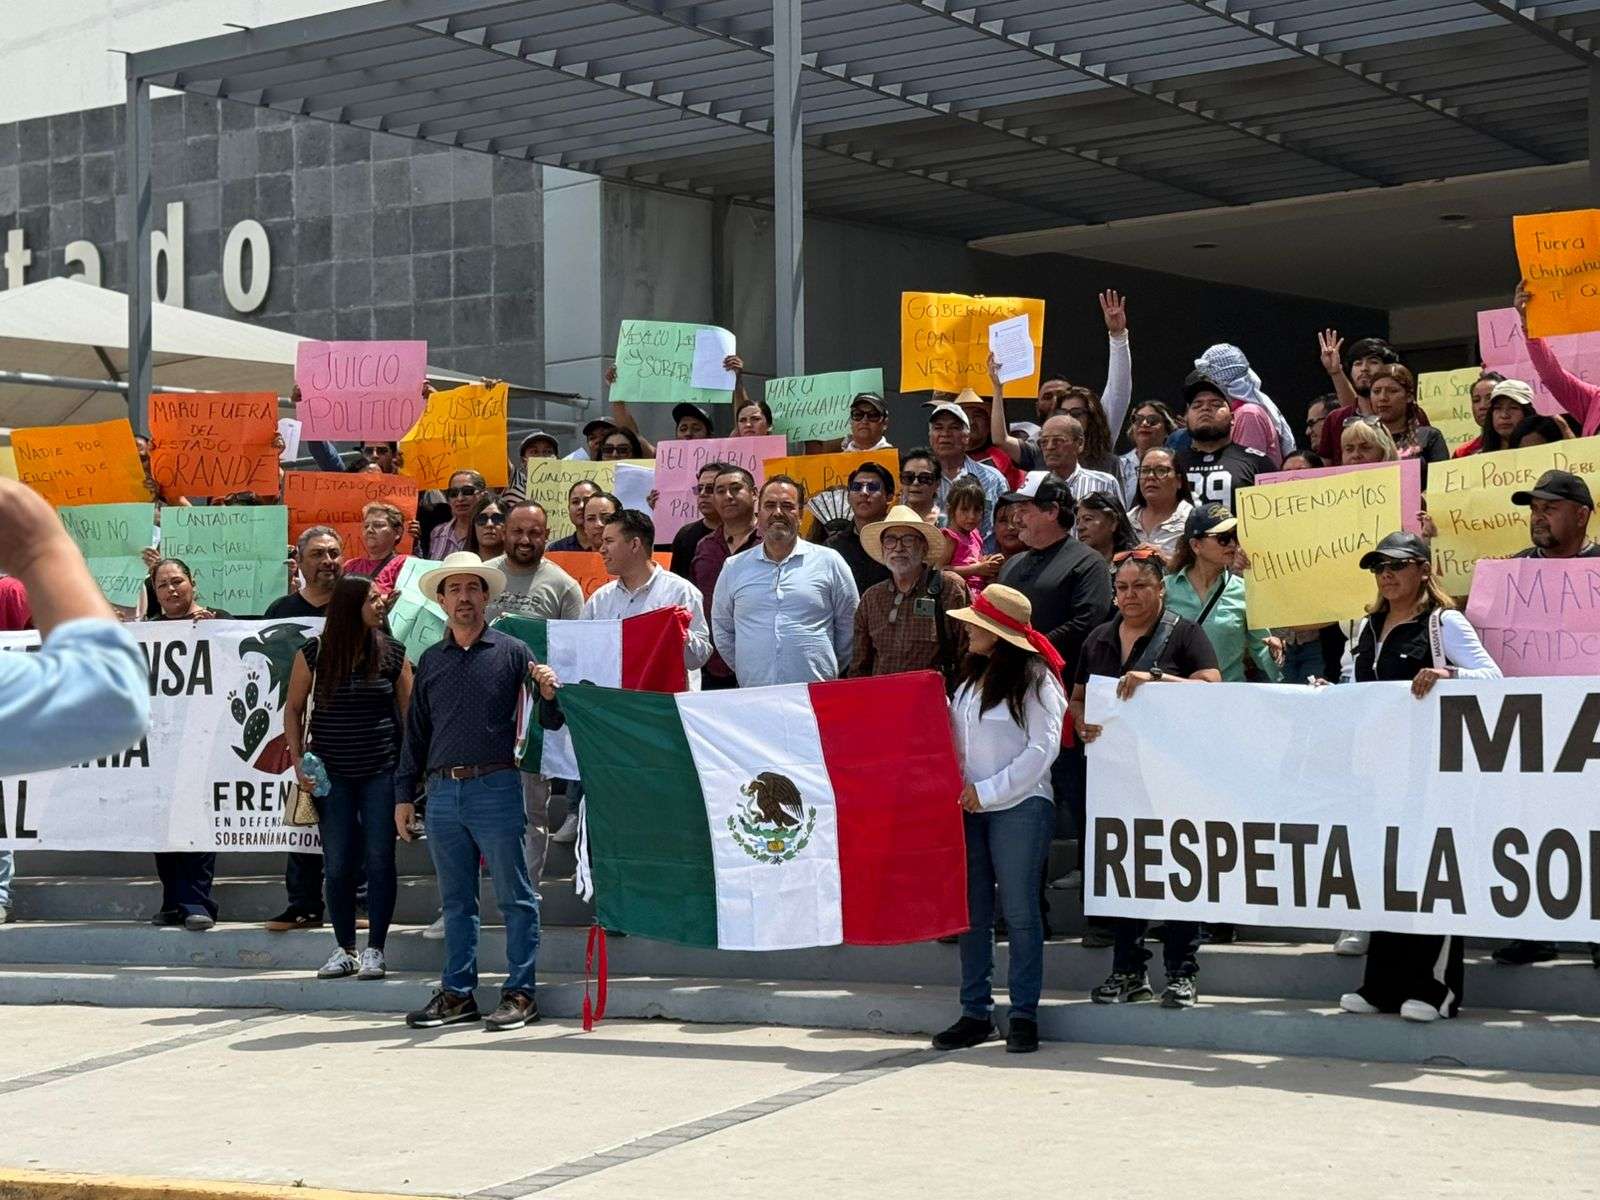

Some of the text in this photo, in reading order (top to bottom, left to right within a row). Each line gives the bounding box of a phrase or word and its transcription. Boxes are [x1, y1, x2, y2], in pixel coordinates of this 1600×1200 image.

[1580, 283, 1599, 298] Q
[907, 297, 1017, 320] GOBERNAR
[914, 328, 989, 352] CON L
[1490, 320, 1523, 348] LA
[312, 351, 400, 391] JUICIO
[767, 377, 816, 399] MARU
[153, 401, 272, 422] MARU FUERA
[301, 393, 415, 434] POLÍTICO
[775, 393, 852, 419] CHIHUAHU
[186, 424, 219, 437] DEL
[18, 439, 103, 460] NADIE POR
[693, 446, 757, 472] PUEBLO
[82, 461, 109, 475] DE
[153, 452, 277, 488] GRANDE
[1445, 452, 1596, 493] EL PODER DEBE
[670, 498, 700, 518] PRI
[107, 517, 129, 542] NO
[1449, 508, 1528, 535] RENDIR
[213, 781, 293, 812] FREN
[215, 817, 231, 828] EN
[1093, 816, 1361, 910] RESPETA
[1383, 825, 1467, 915] LA
